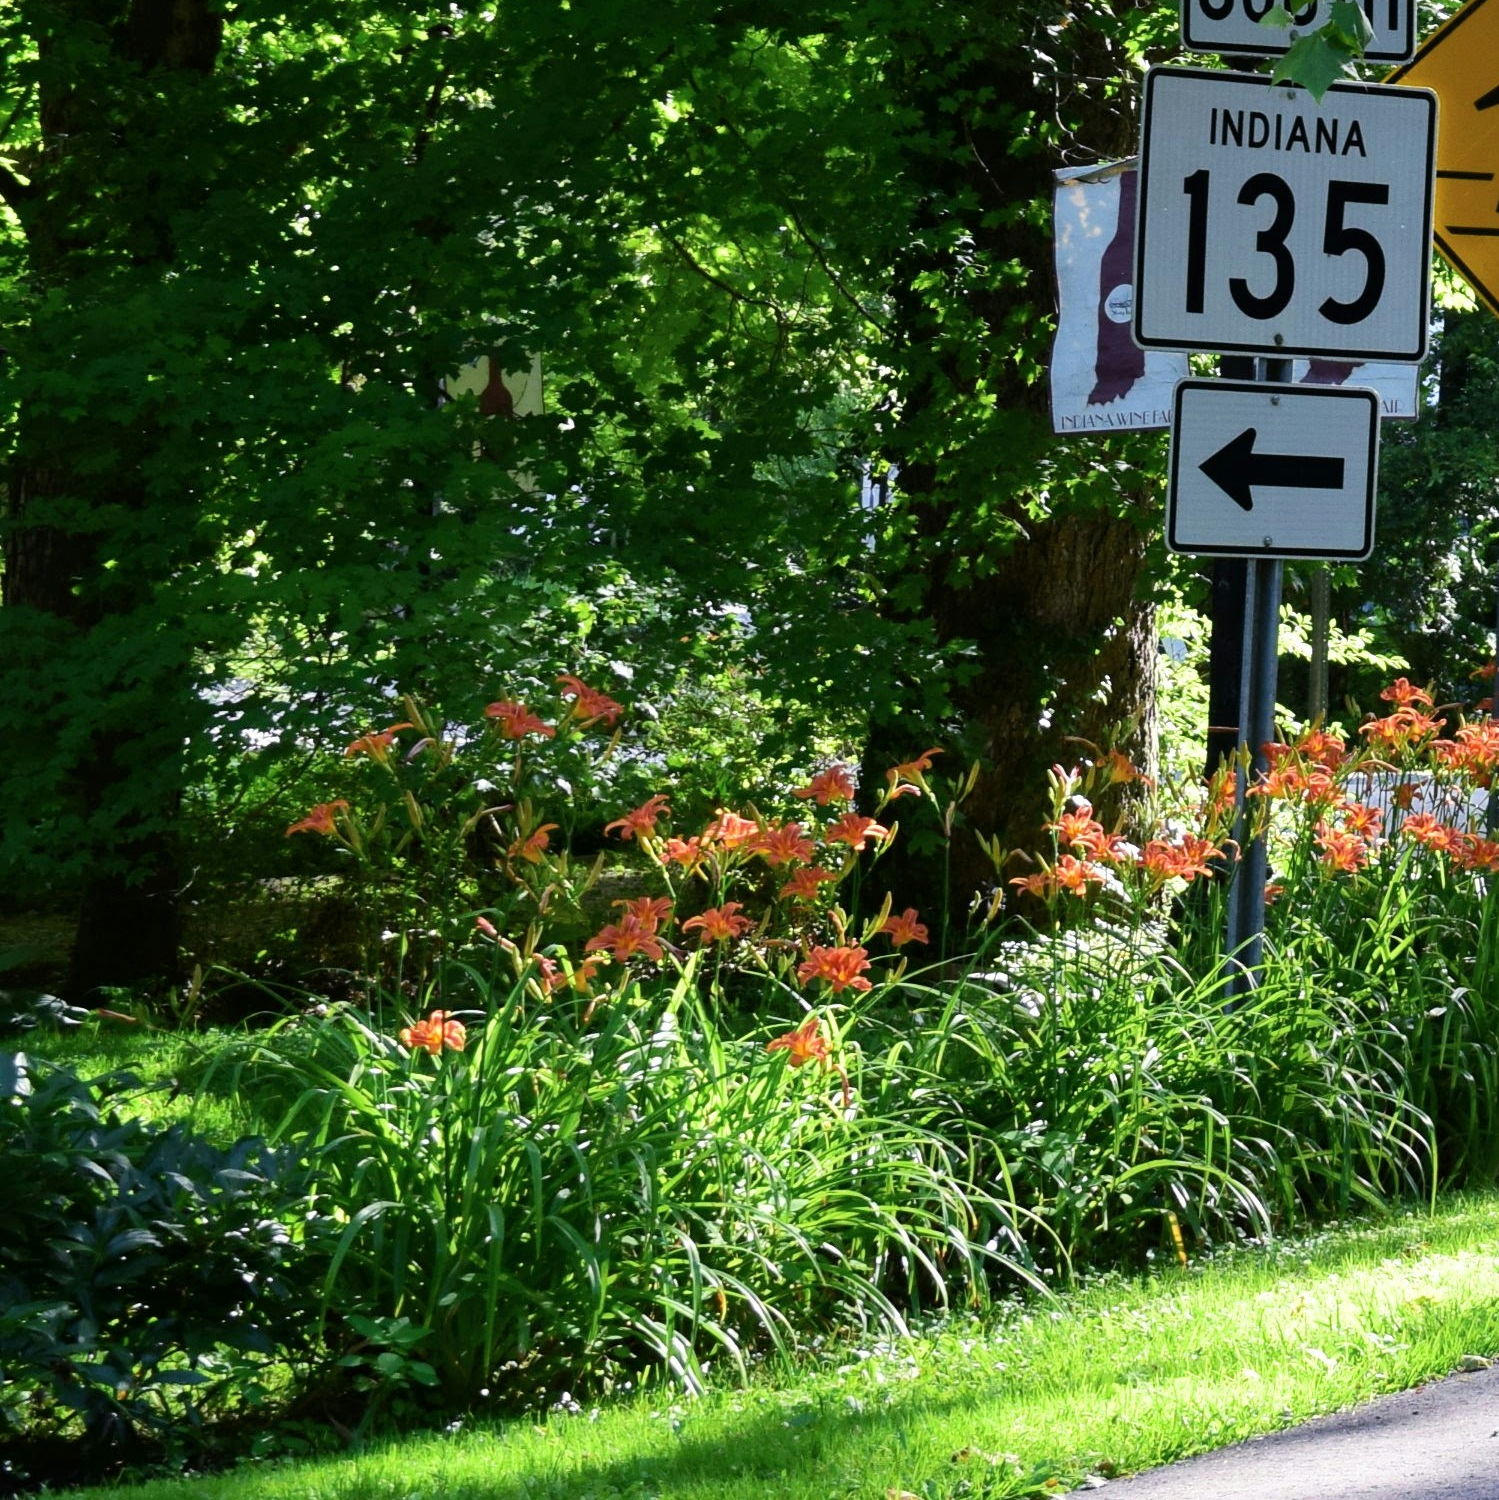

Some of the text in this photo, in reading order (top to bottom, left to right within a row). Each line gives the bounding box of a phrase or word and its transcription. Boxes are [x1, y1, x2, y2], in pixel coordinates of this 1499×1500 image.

[1209, 107, 1367, 157] INDIANA
[1183, 169, 1390, 325] 135
[1061, 412, 1114, 430] INDIANA
[1116, 410, 1150, 426] WINE
